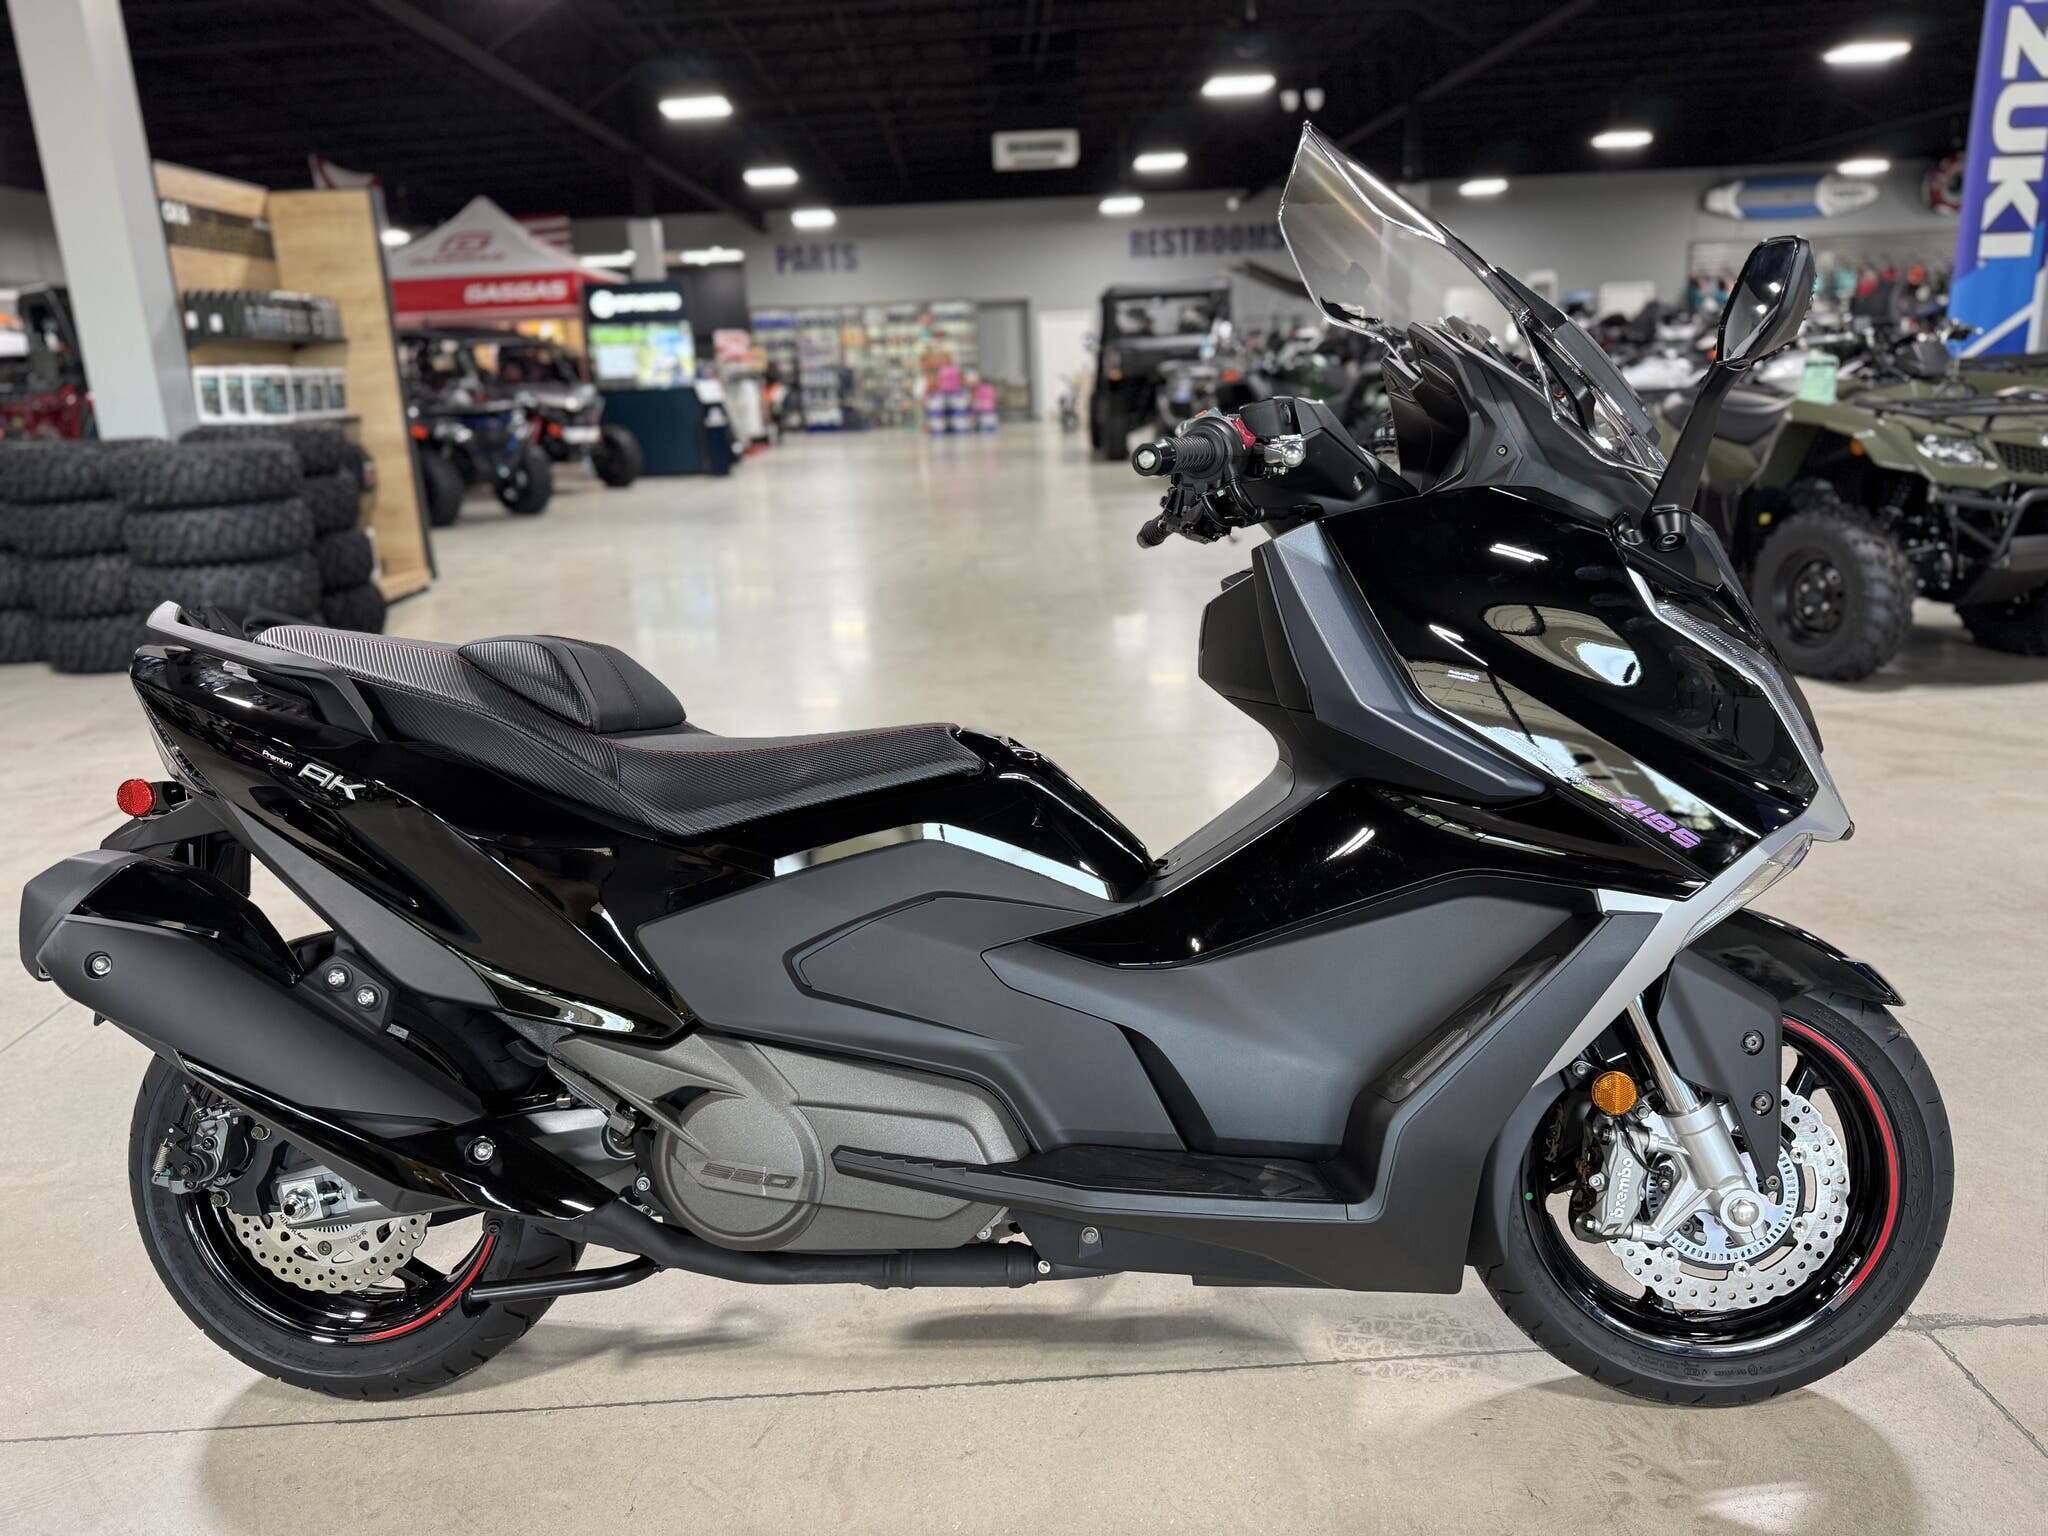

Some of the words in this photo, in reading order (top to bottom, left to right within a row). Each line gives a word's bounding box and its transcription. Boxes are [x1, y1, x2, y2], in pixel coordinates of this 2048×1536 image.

[1977, 0, 2048, 259] ZUKI
[775, 243, 859, 274] PARTS
[1129, 223, 1286, 258] RESTROOMS
[463, 279, 568, 305] GASGAS
[262, 749, 293, 769] Premium
[297, 762, 366, 800] AK
[1609, 1157, 1634, 1219] brembo
